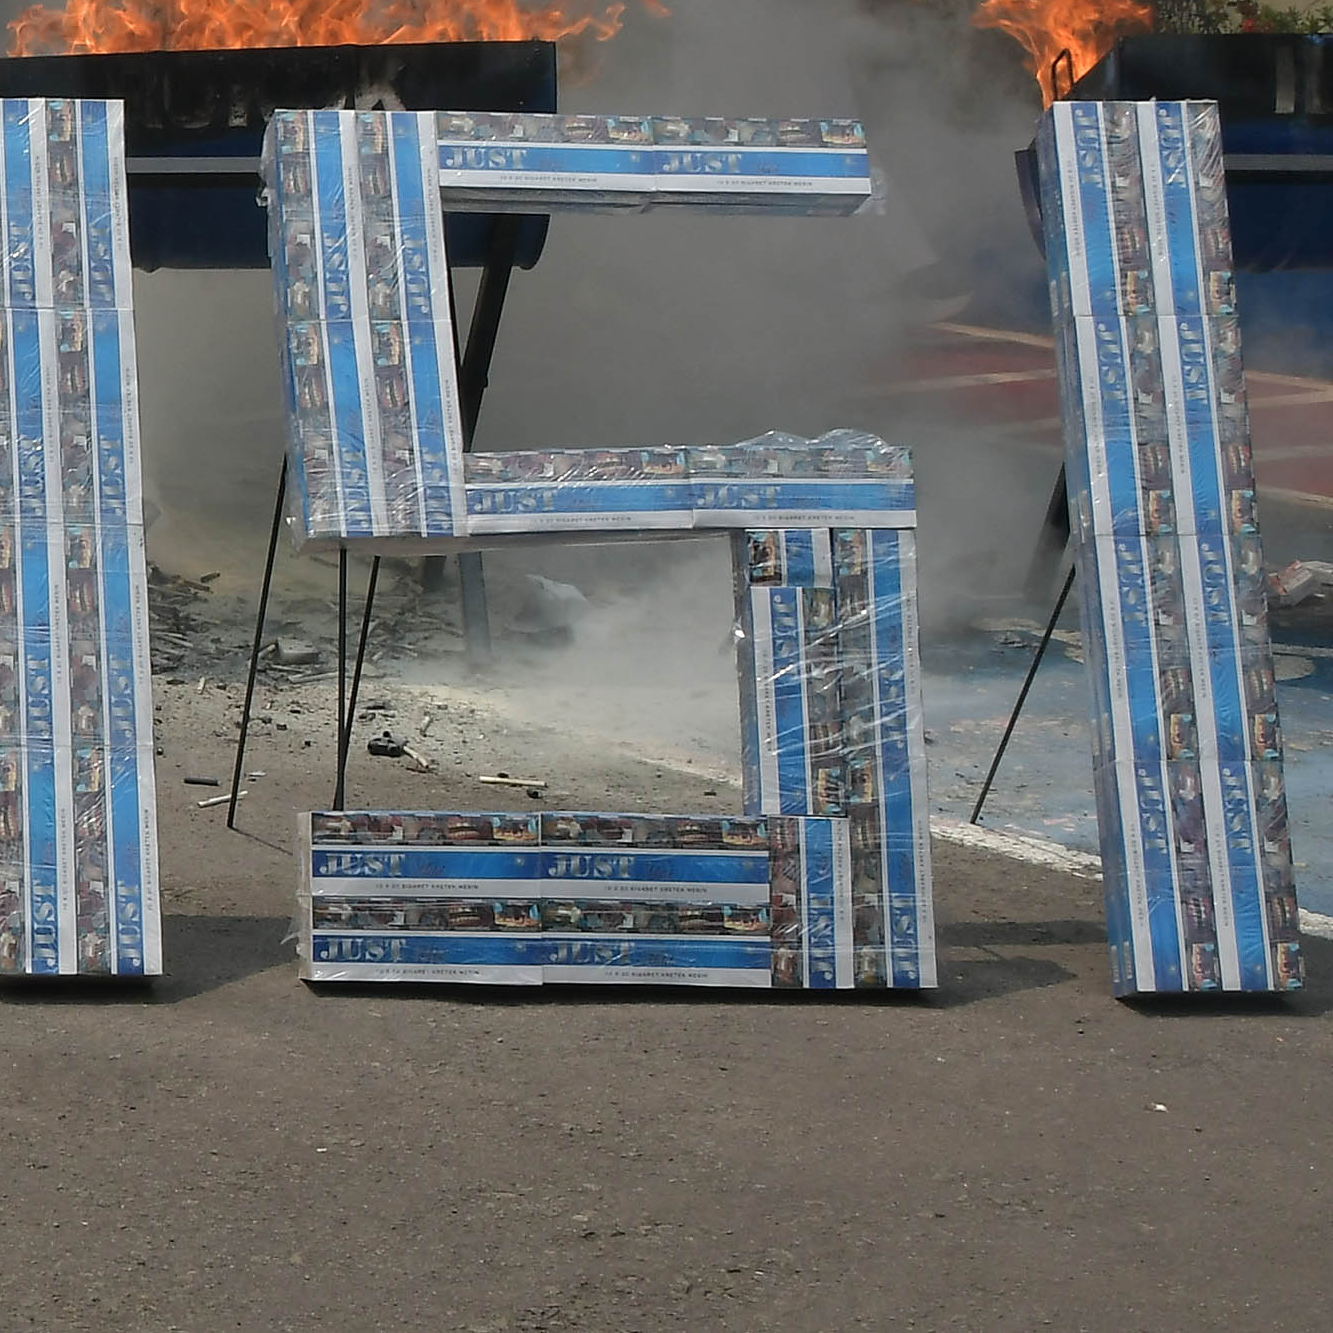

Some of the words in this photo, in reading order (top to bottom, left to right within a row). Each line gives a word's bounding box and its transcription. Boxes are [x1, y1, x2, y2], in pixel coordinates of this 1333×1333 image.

[445, 146, 530, 171] JUST
[661, 152, 744, 174] JUST
[1074, 108, 1104, 190] JUST
[1099, 321, 1128, 404] JUST
[1179, 321, 1209, 406] JUST
[472, 487, 558, 513] JUST
[26, 653, 51, 739] JUST
[109, 653, 135, 739] JUST
[318, 852, 407, 877] JUST
[548, 854, 636, 879] JUST
[32, 880, 57, 968] JUST
[116, 880, 142, 968] JUST
[320, 936, 408, 961] JUST
[548, 938, 634, 965] JUST
